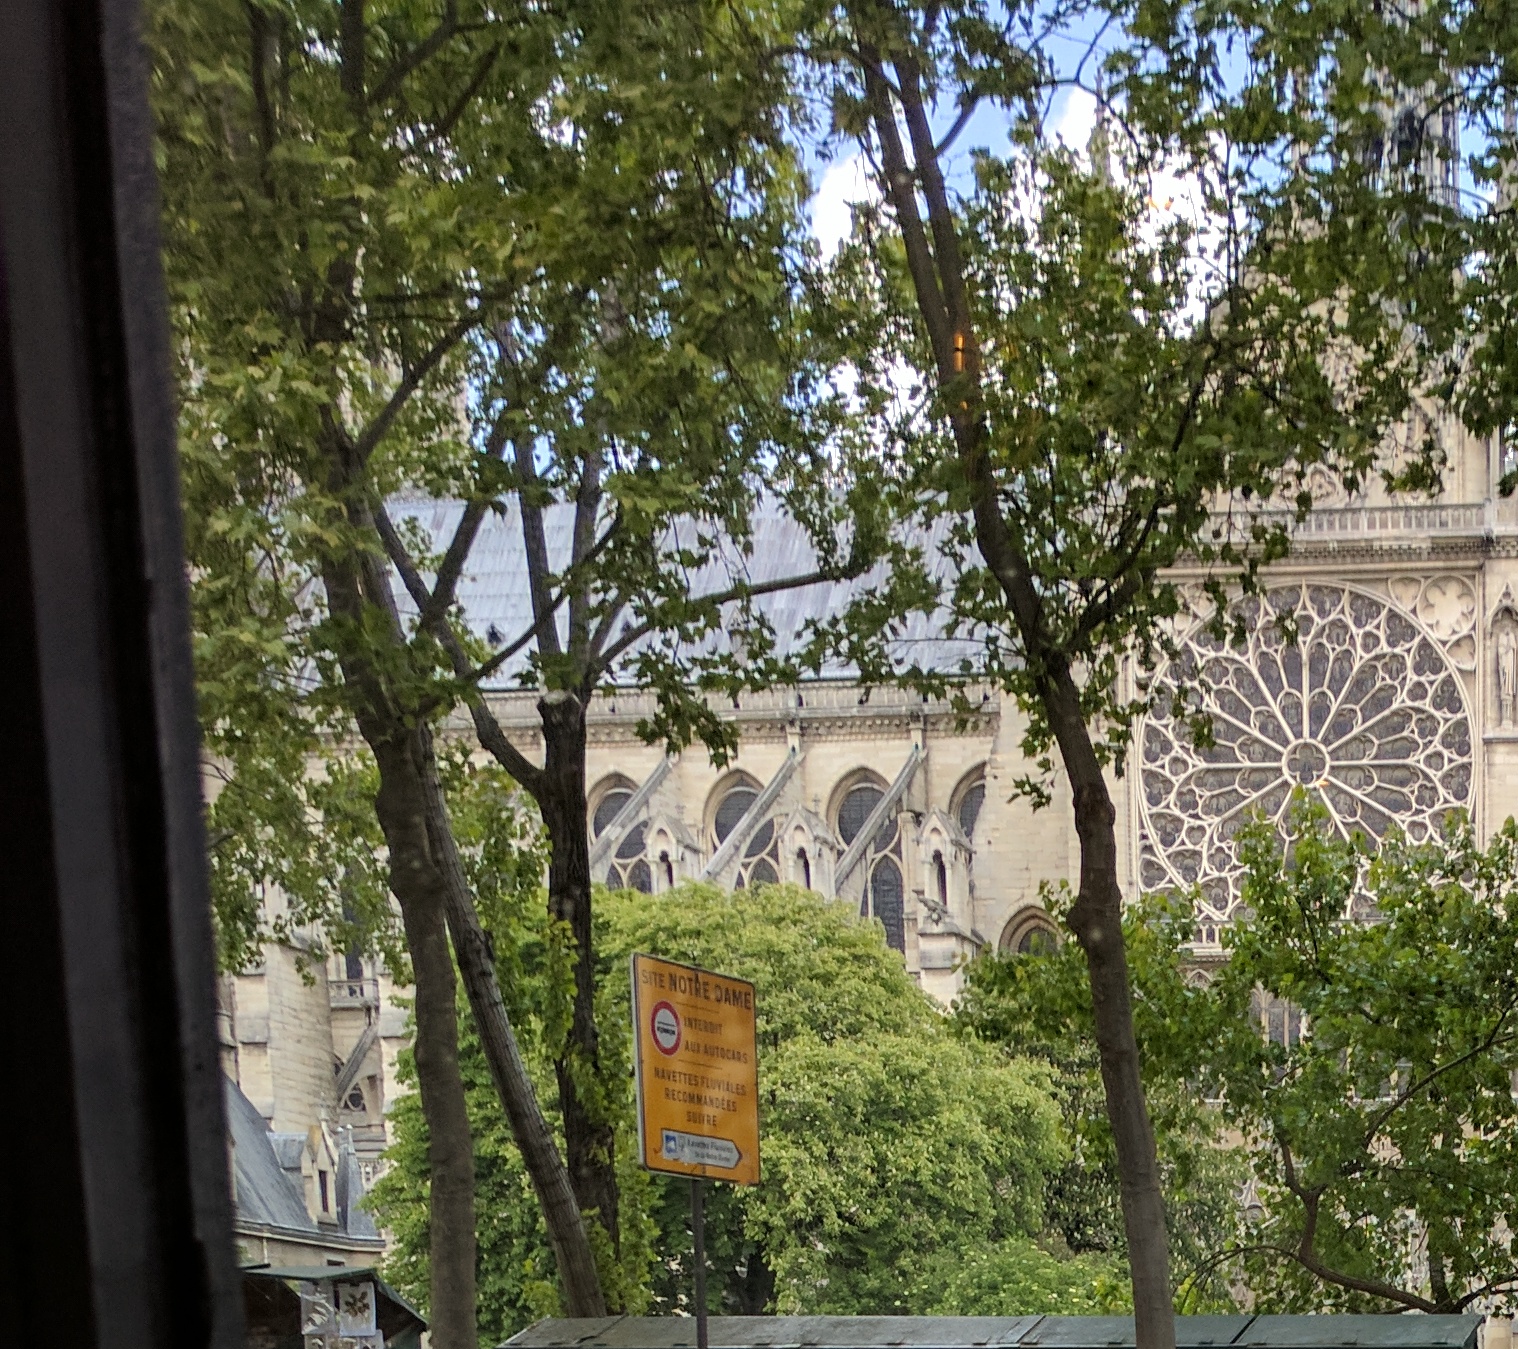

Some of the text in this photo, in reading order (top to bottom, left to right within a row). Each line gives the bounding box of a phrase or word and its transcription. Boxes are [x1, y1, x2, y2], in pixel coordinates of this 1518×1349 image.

[641, 969, 752, 1010] SITE NOTRE DAME
[683, 1016, 723, 1035] INTERDIT
[684, 1040, 748, 1064] AUX AUTOCARS
[654, 1066, 747, 1096] NAVETTES FLUVIALES
[686, 1111, 717, 1127] SUIVRE
